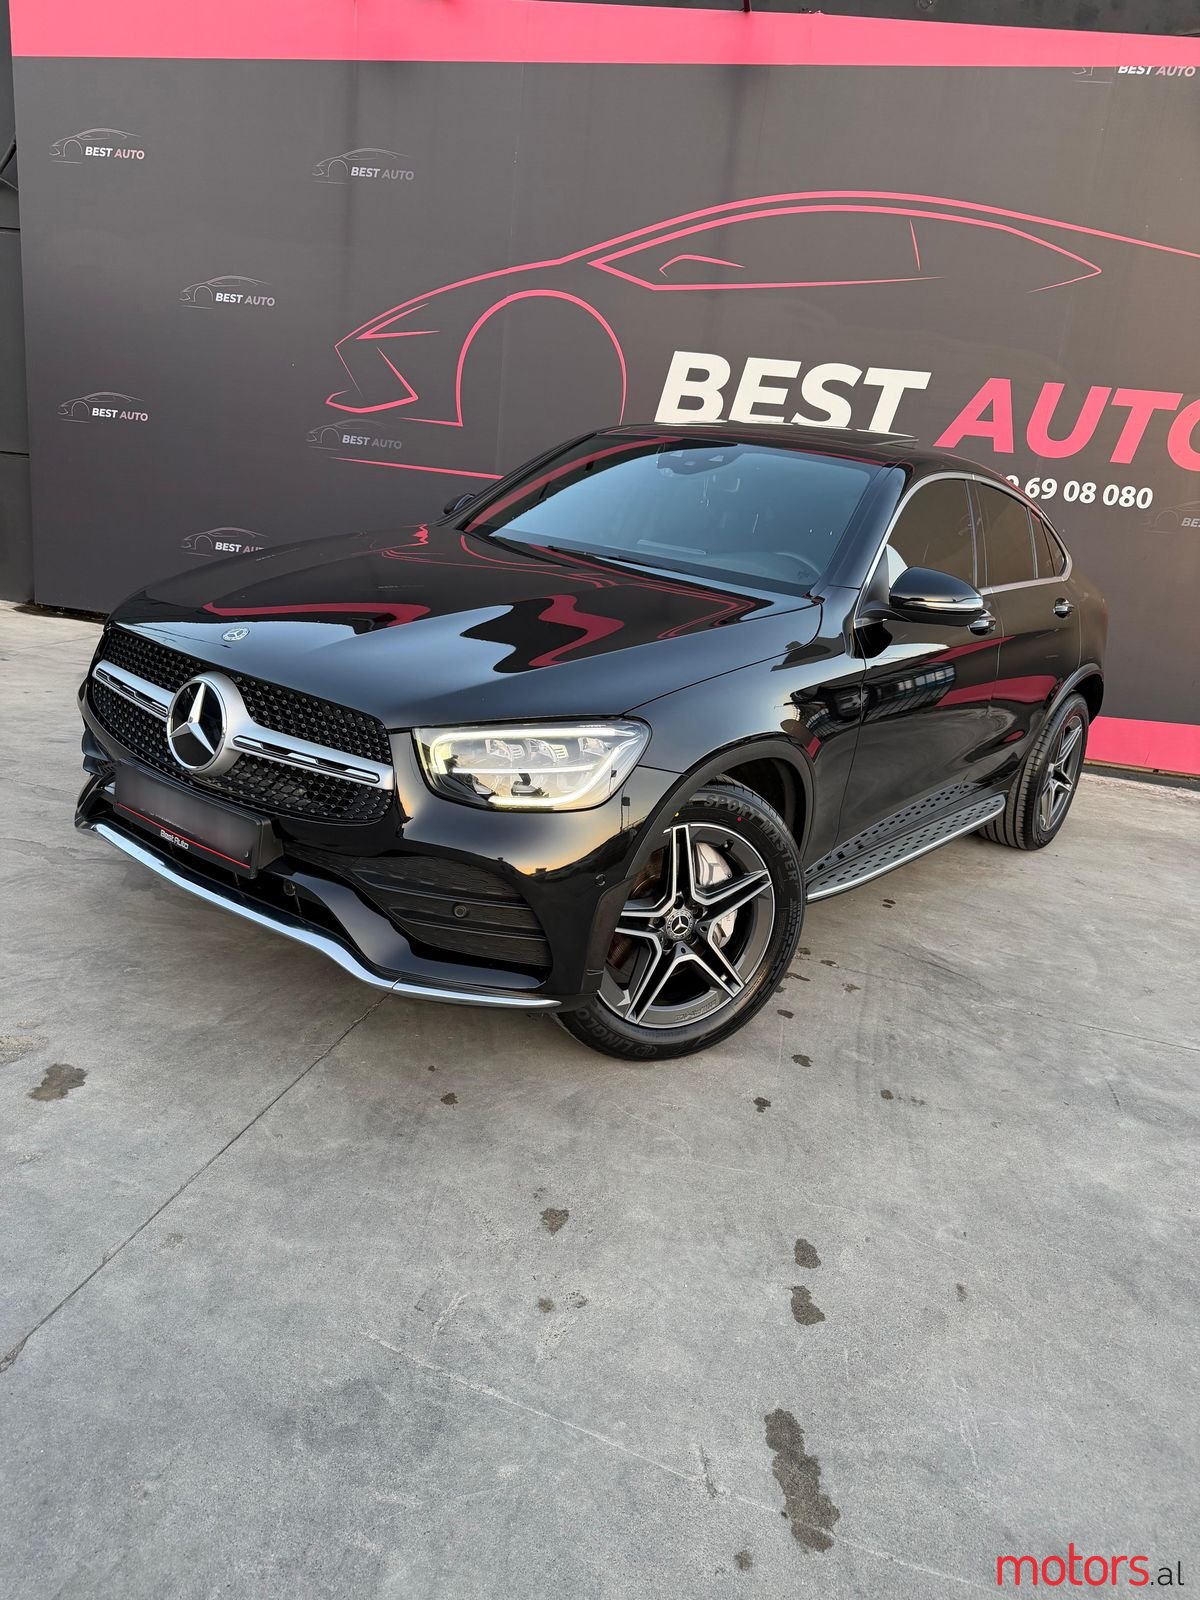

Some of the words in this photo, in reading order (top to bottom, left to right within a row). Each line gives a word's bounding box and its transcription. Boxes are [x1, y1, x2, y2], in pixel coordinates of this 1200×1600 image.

[1118, 66, 1155, 75] BEST
[1155, 66, 1196, 77] AUTO
[85, 146, 113, 157] BEST
[114, 149, 145, 160] AUTO
[351, 166, 380, 178] BEST
[381, 170, 415, 180] AUTO
[215, 292, 243, 303] BEST
[244, 296, 275, 307] AUTO
[654, 350, 932, 435] BEST
[92, 407, 119, 418] BEST
[119, 411, 149, 422] AUTO
[342, 434, 371, 446] BEST
[371, 438, 402, 449] AUTO
[1024, 477, 1058, 500] 69
[1063, 480, 1097, 504] 08
[1102, 484, 1153, 509] 080
[1181, 517, 1200, 528] BE
[215, 541, 242, 552] BEST
[704, 794, 757, 821] SPORT
[760, 819, 798, 881] MASTER
